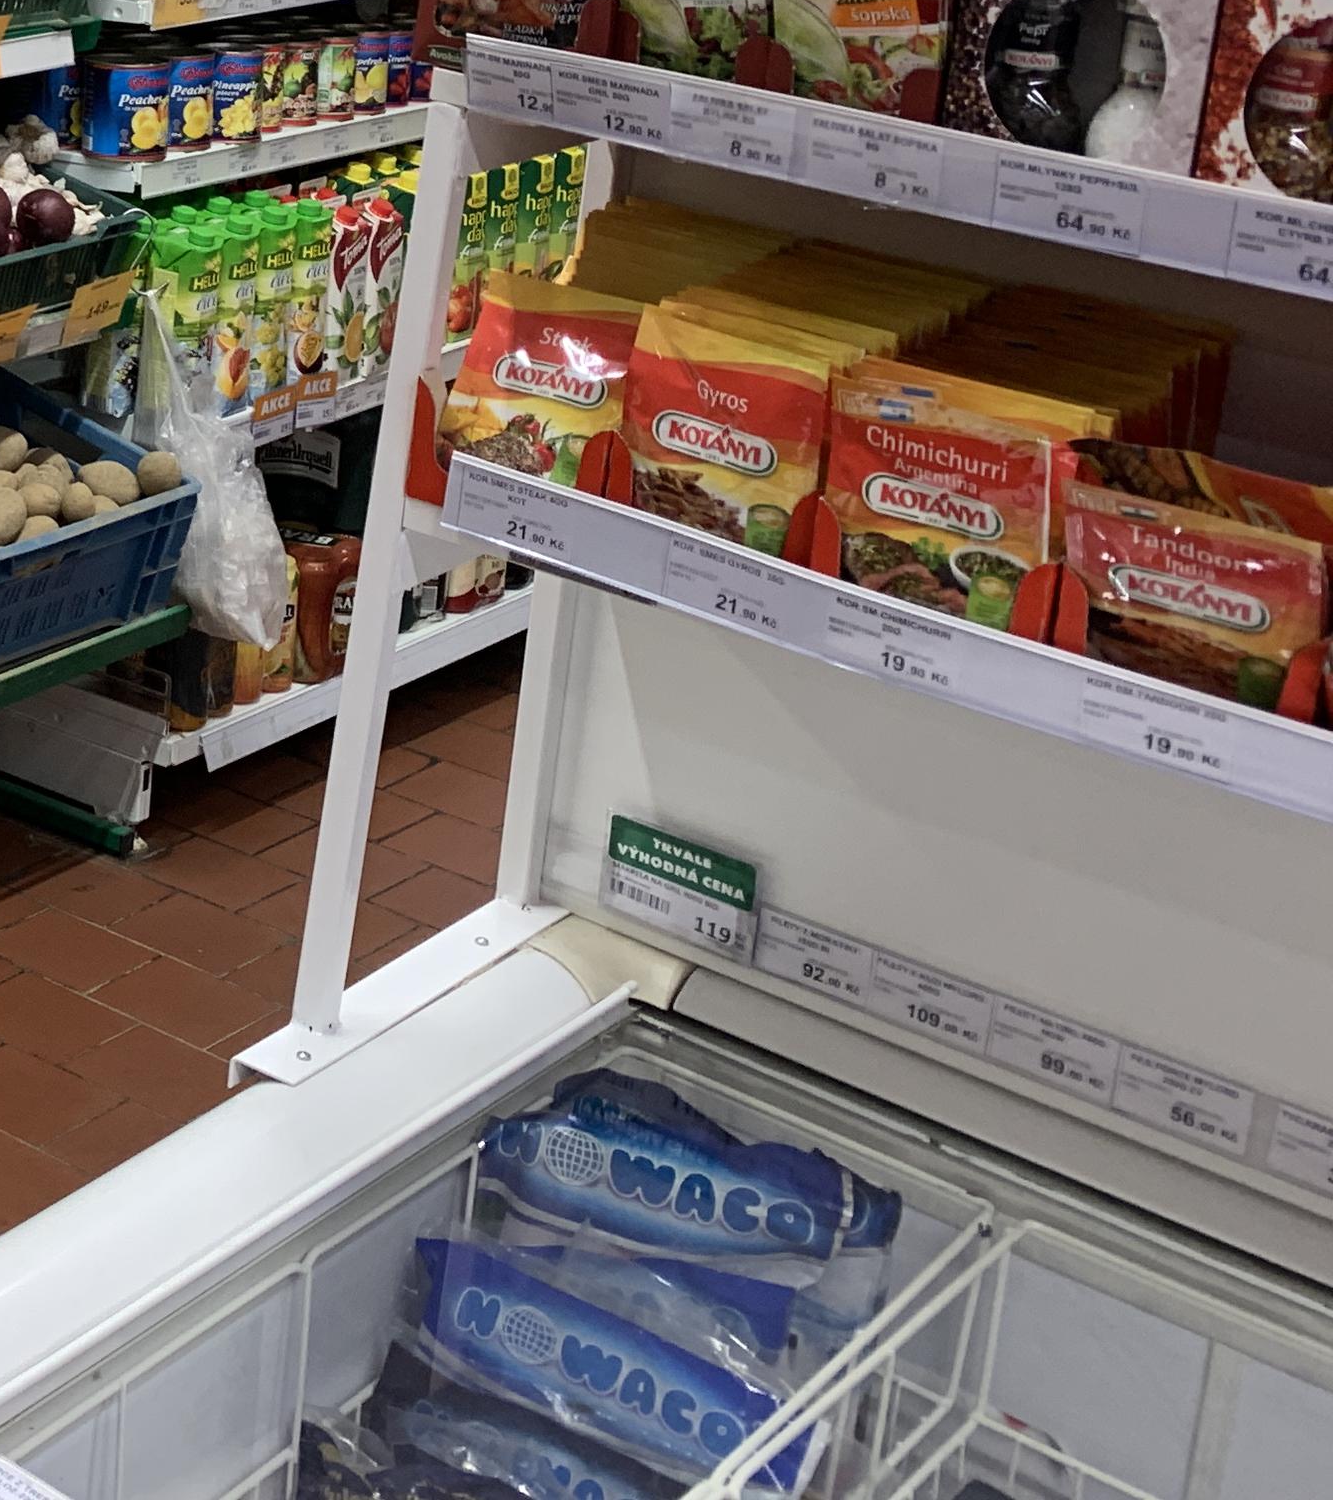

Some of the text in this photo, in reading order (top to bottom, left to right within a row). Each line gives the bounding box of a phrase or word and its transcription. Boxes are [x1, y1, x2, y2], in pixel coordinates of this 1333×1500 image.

[850, 5, 912, 25] šopská
[303, 378, 332, 396] AKCE
[505, 361, 596, 400] KOTÁNYI
[697, 379, 750, 413] Gyros
[261, 393, 292, 416] AKCE
[668, 419, 763, 467] KOTÁNYI
[865, 423, 1009, 483] Chimichurri
[893, 456, 979, 495] Argentina
[879, 482, 988, 531] KOTÁNYI
[550, 538, 565, 552] Kč
[1164, 555, 1217, 581] India
[1127, 573, 1253, 624] KOTÁNYI
[762, 615, 778, 630] Kč
[931, 671, 950, 687] Kč
[1202, 756, 1222, 770] Kč
[652, 836, 712, 870] TRVALE
[616, 842, 699, 885] VÝHODNÁ
[702, 874, 747, 902] CENA
[694, 915, 732, 945] 119
